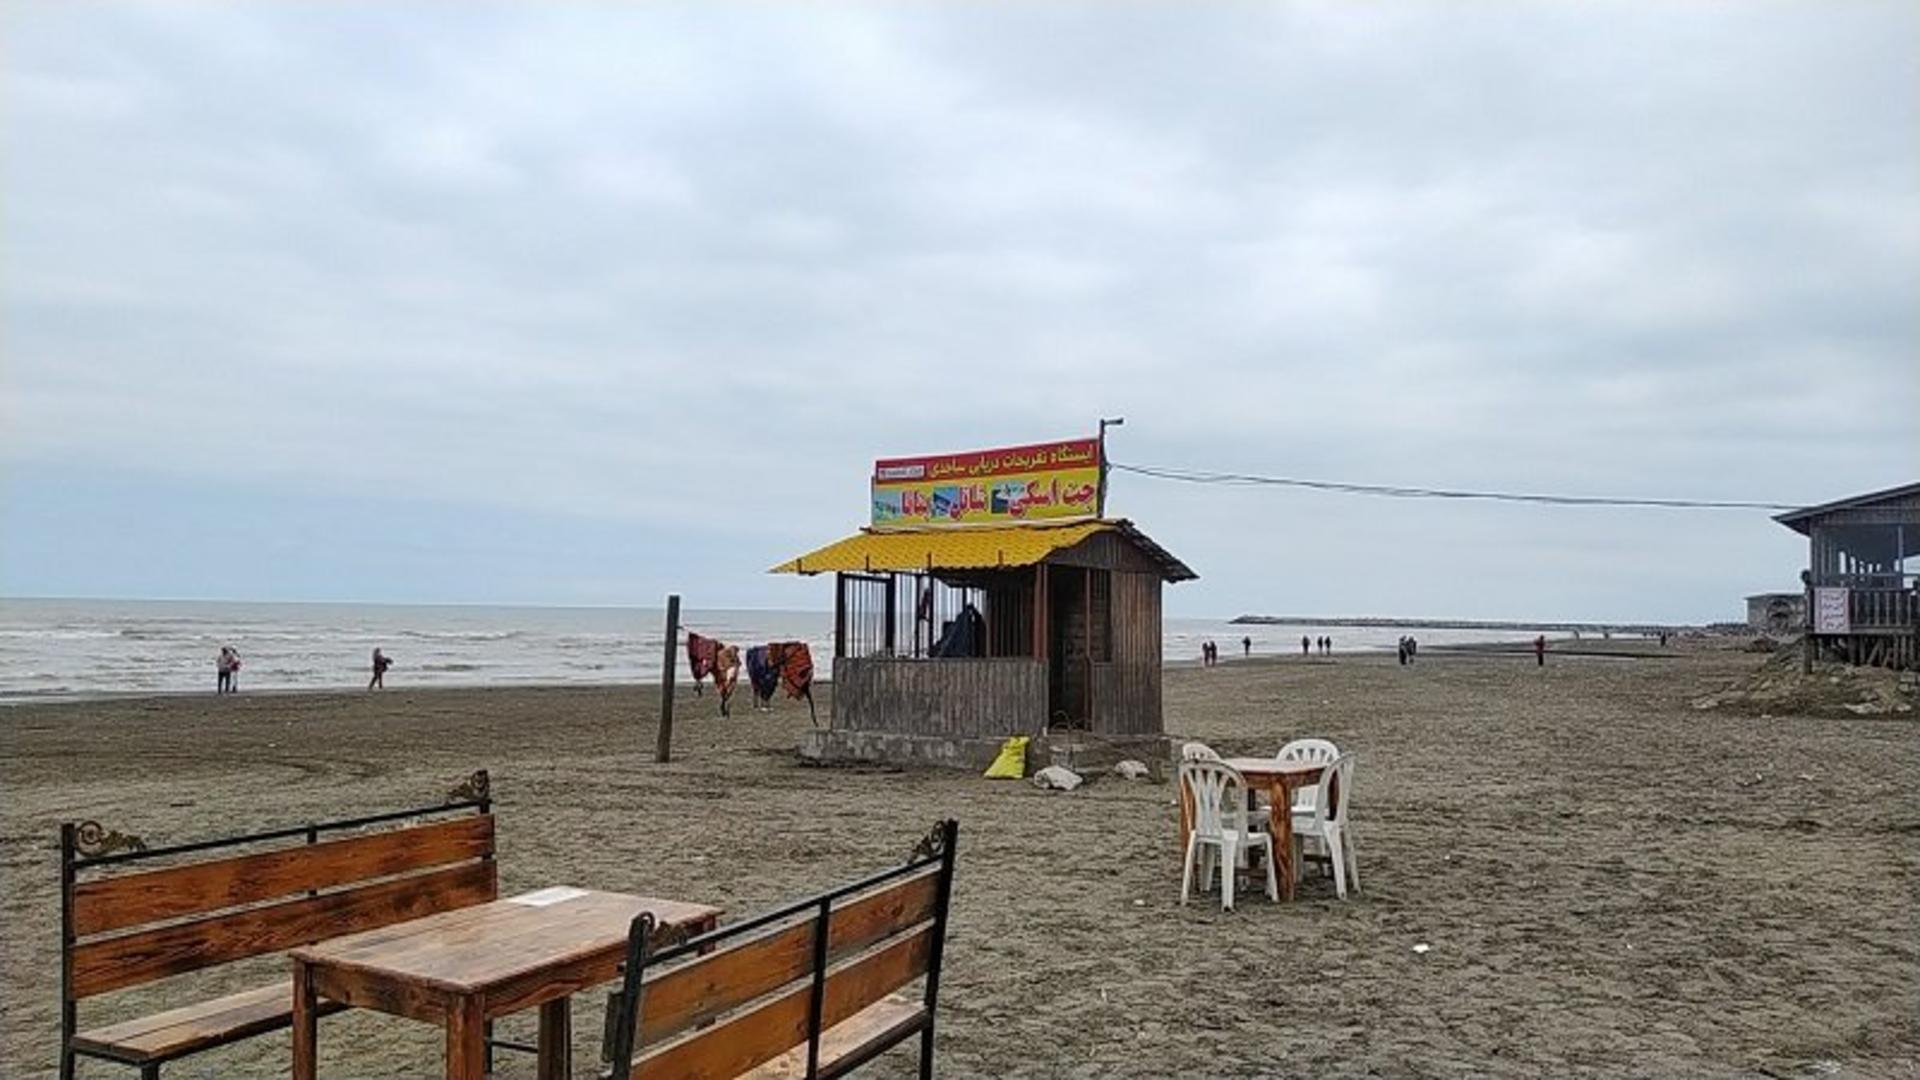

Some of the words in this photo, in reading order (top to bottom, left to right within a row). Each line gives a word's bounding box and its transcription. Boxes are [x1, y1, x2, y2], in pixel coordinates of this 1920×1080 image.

[1003, 449, 1047, 470] تفریحات
[1051, 443, 1093, 464] ایستگاه
[1009, 478, 1060, 517] اسکی
[1061, 480, 1094, 513] جت
